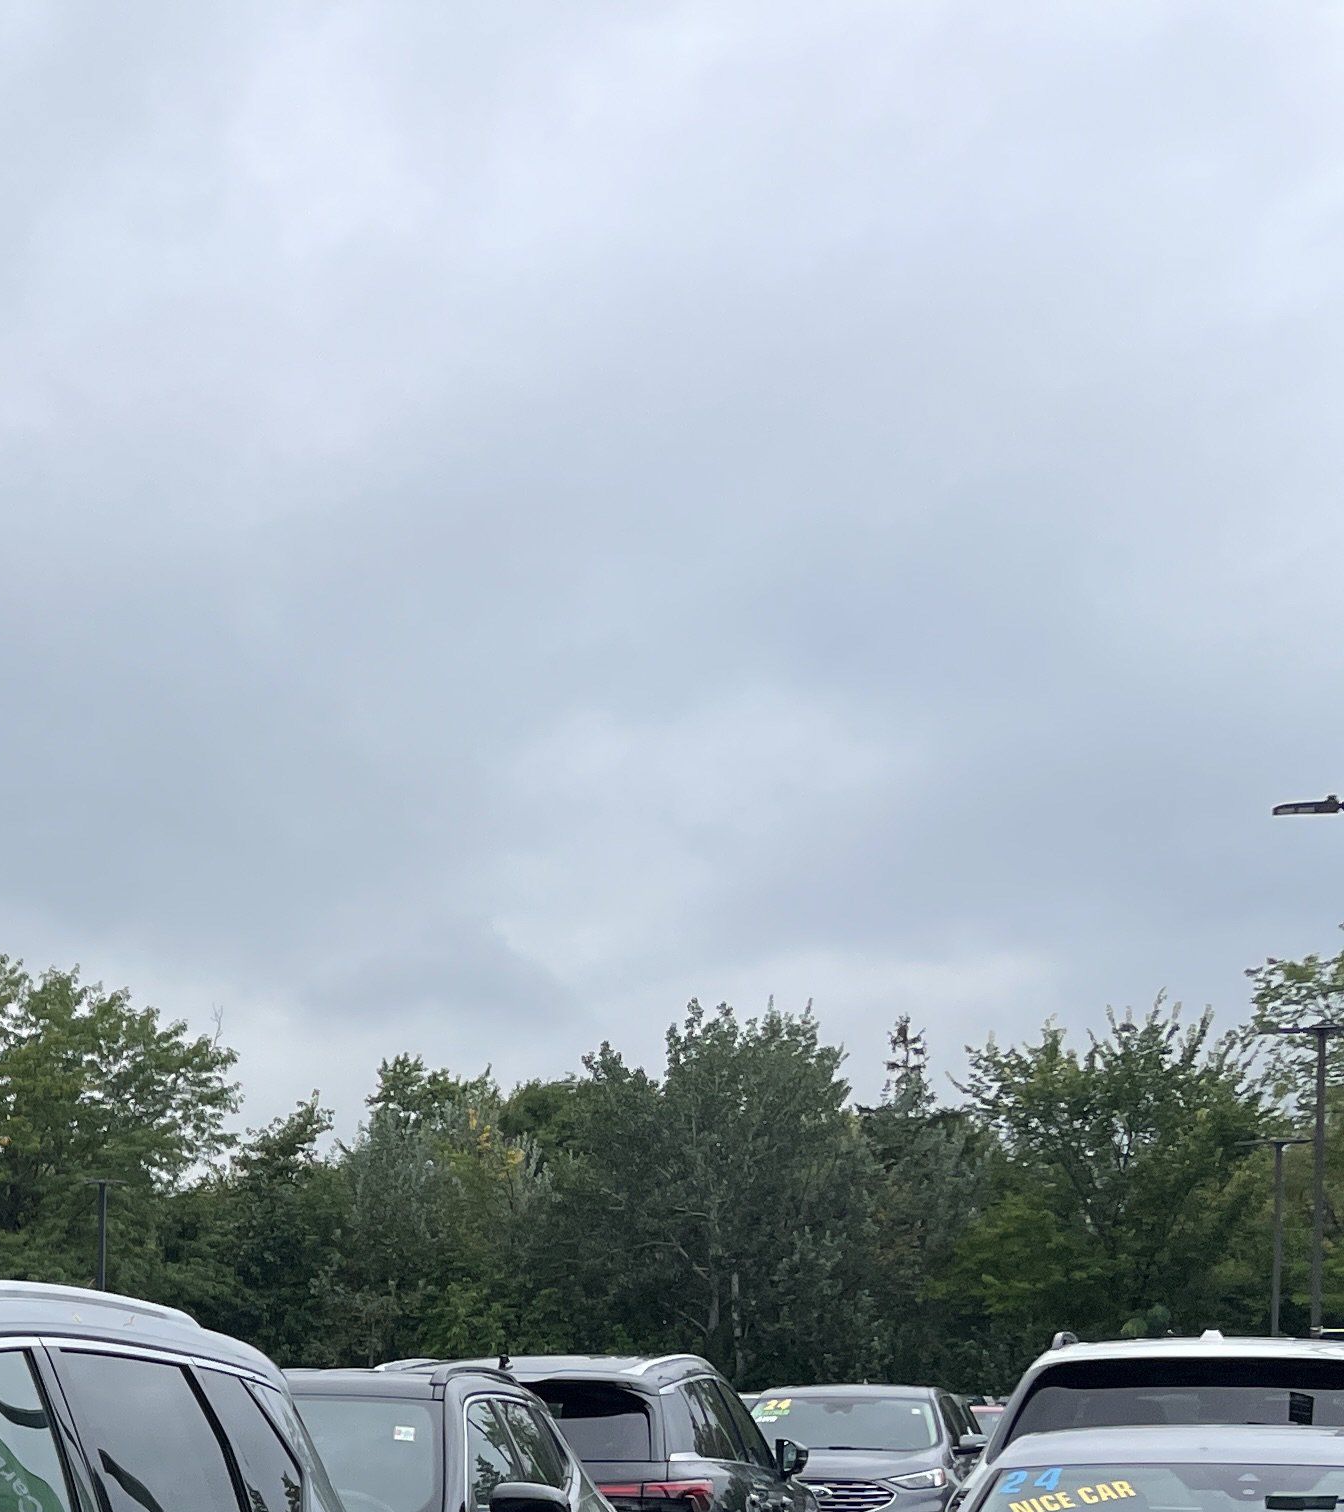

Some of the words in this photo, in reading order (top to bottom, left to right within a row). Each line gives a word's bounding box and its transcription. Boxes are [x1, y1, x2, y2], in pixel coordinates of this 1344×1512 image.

[763, 1398, 792, 1410] 24
[998, 1467, 1064, 1494] 24
[1077, 1480, 1136, 1504] CAR
